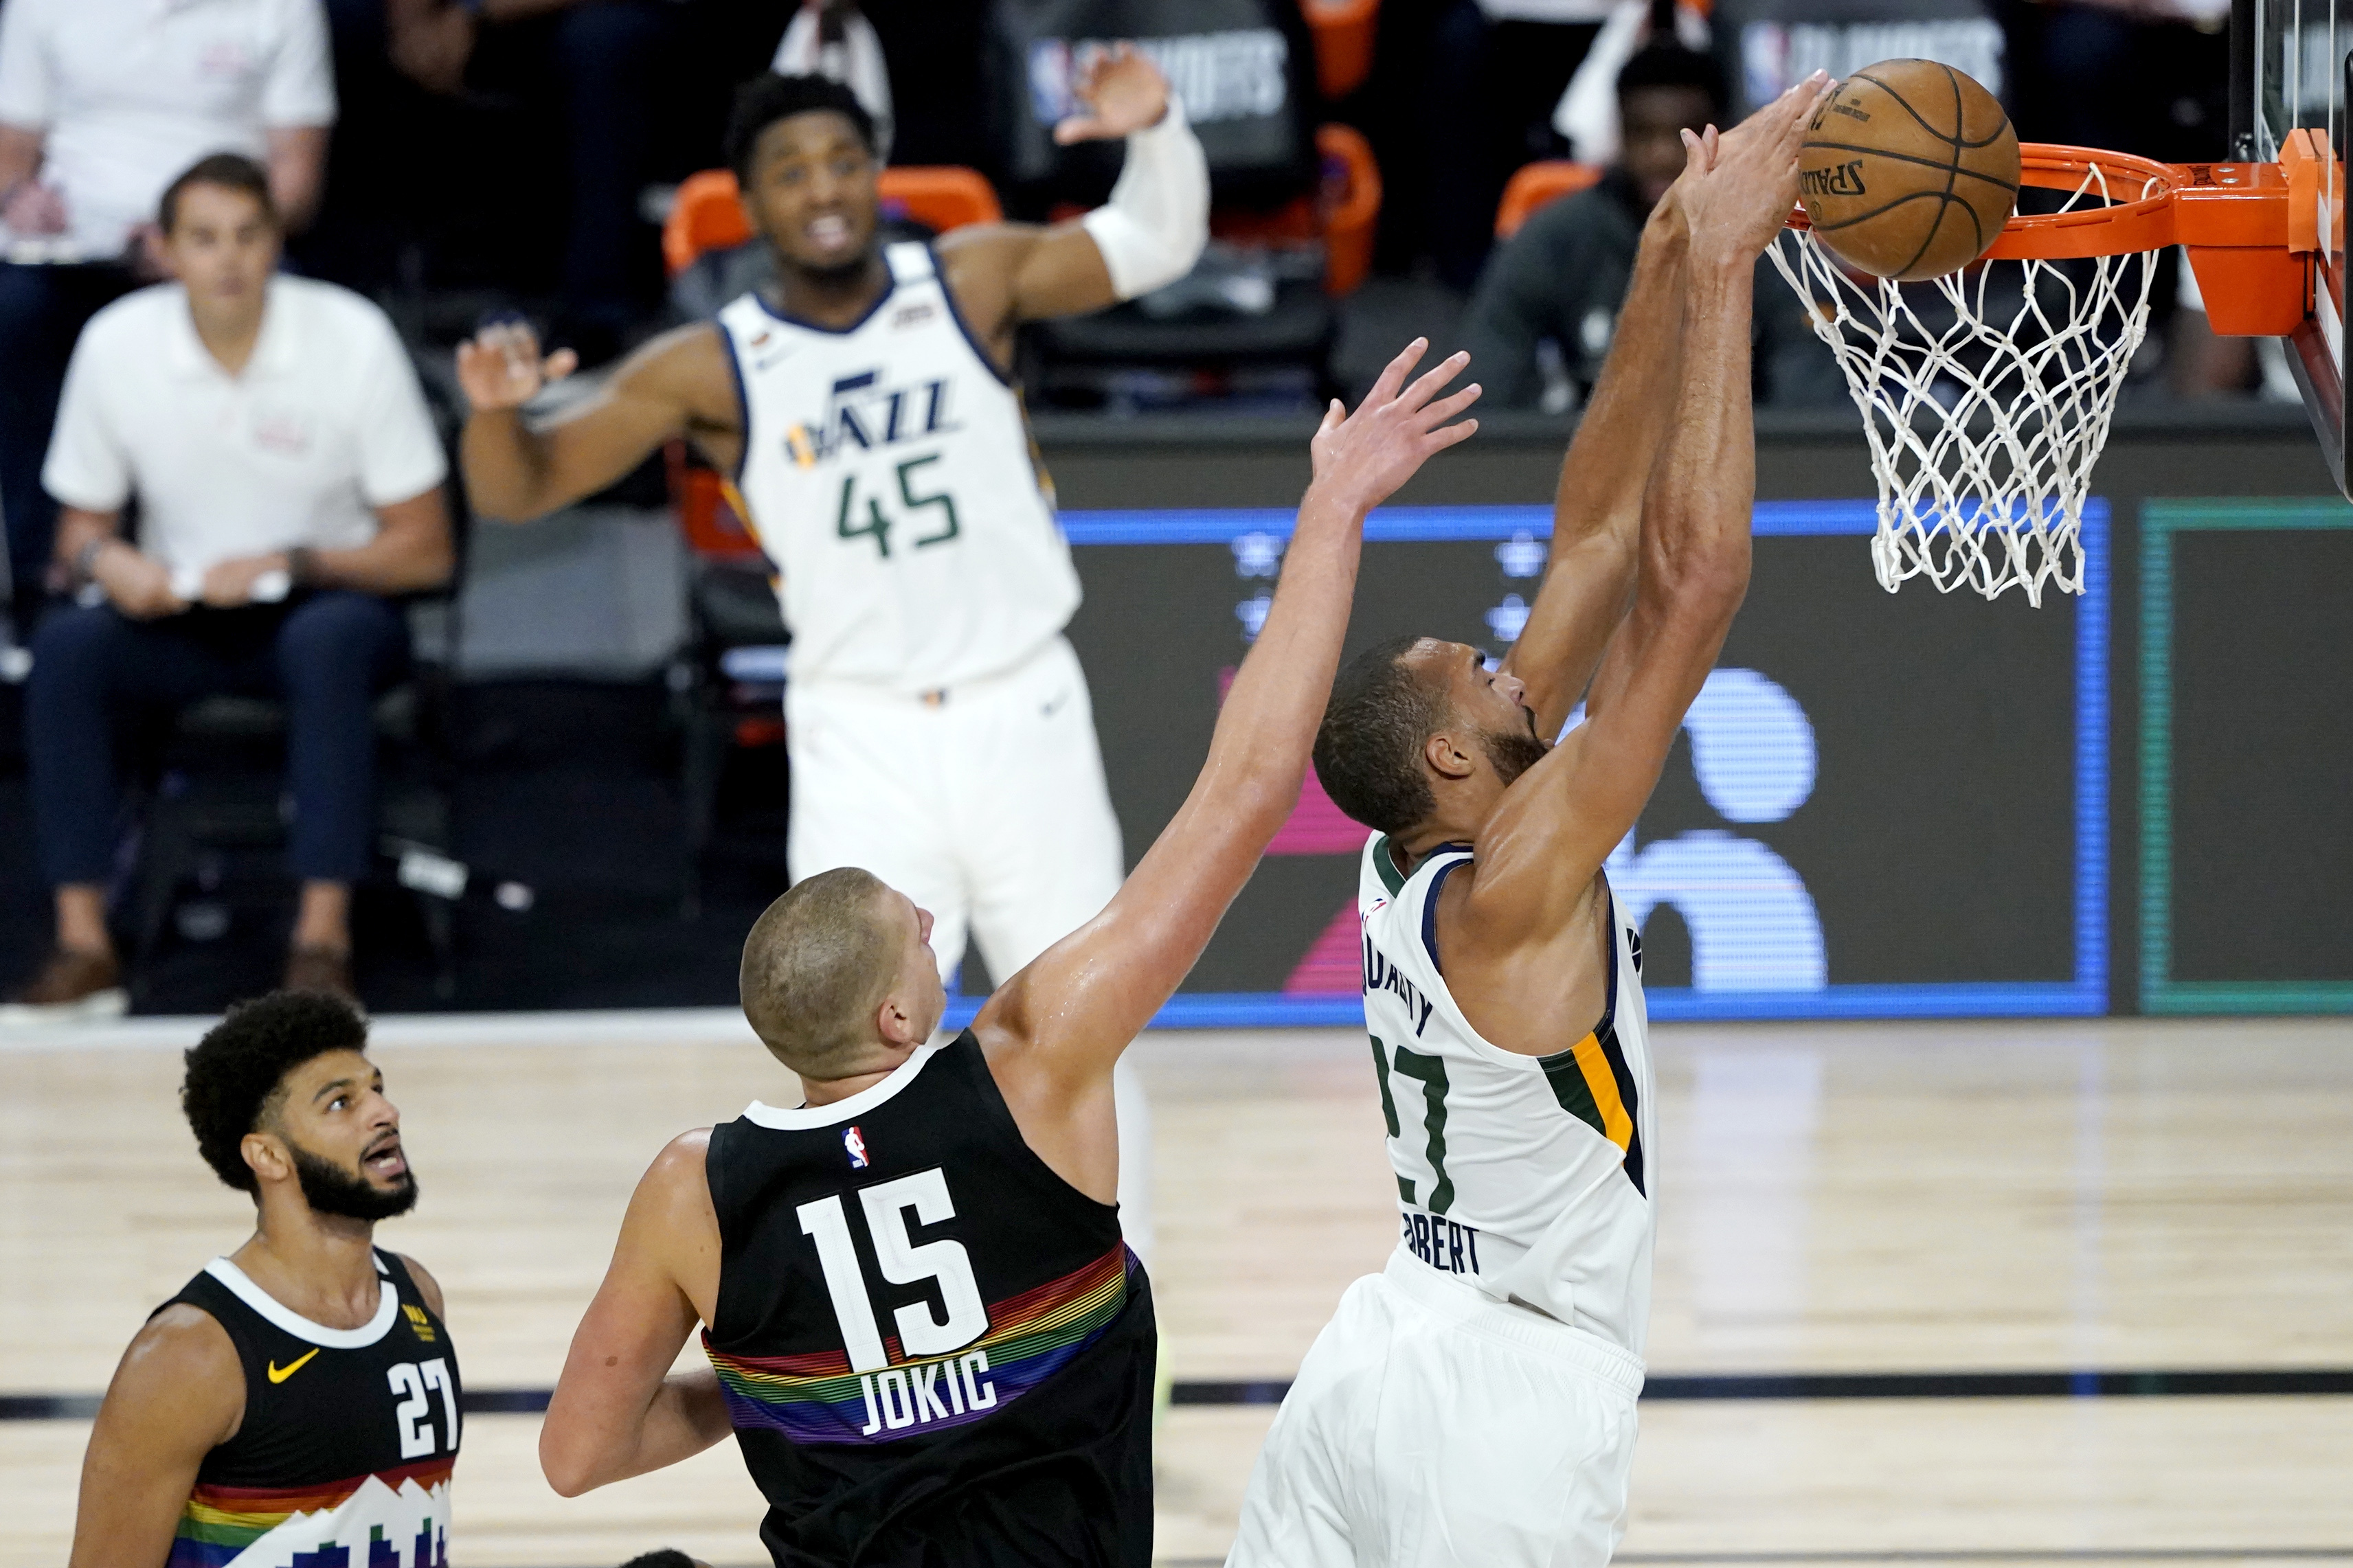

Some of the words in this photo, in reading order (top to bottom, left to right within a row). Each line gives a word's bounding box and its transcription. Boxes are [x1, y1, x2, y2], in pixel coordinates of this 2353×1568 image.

[837, 452, 961, 558] 45
[796, 1167, 989, 1374] 15
[386, 1357, 458, 1459] 27
[861, 1350, 998, 1436] JOKIC
